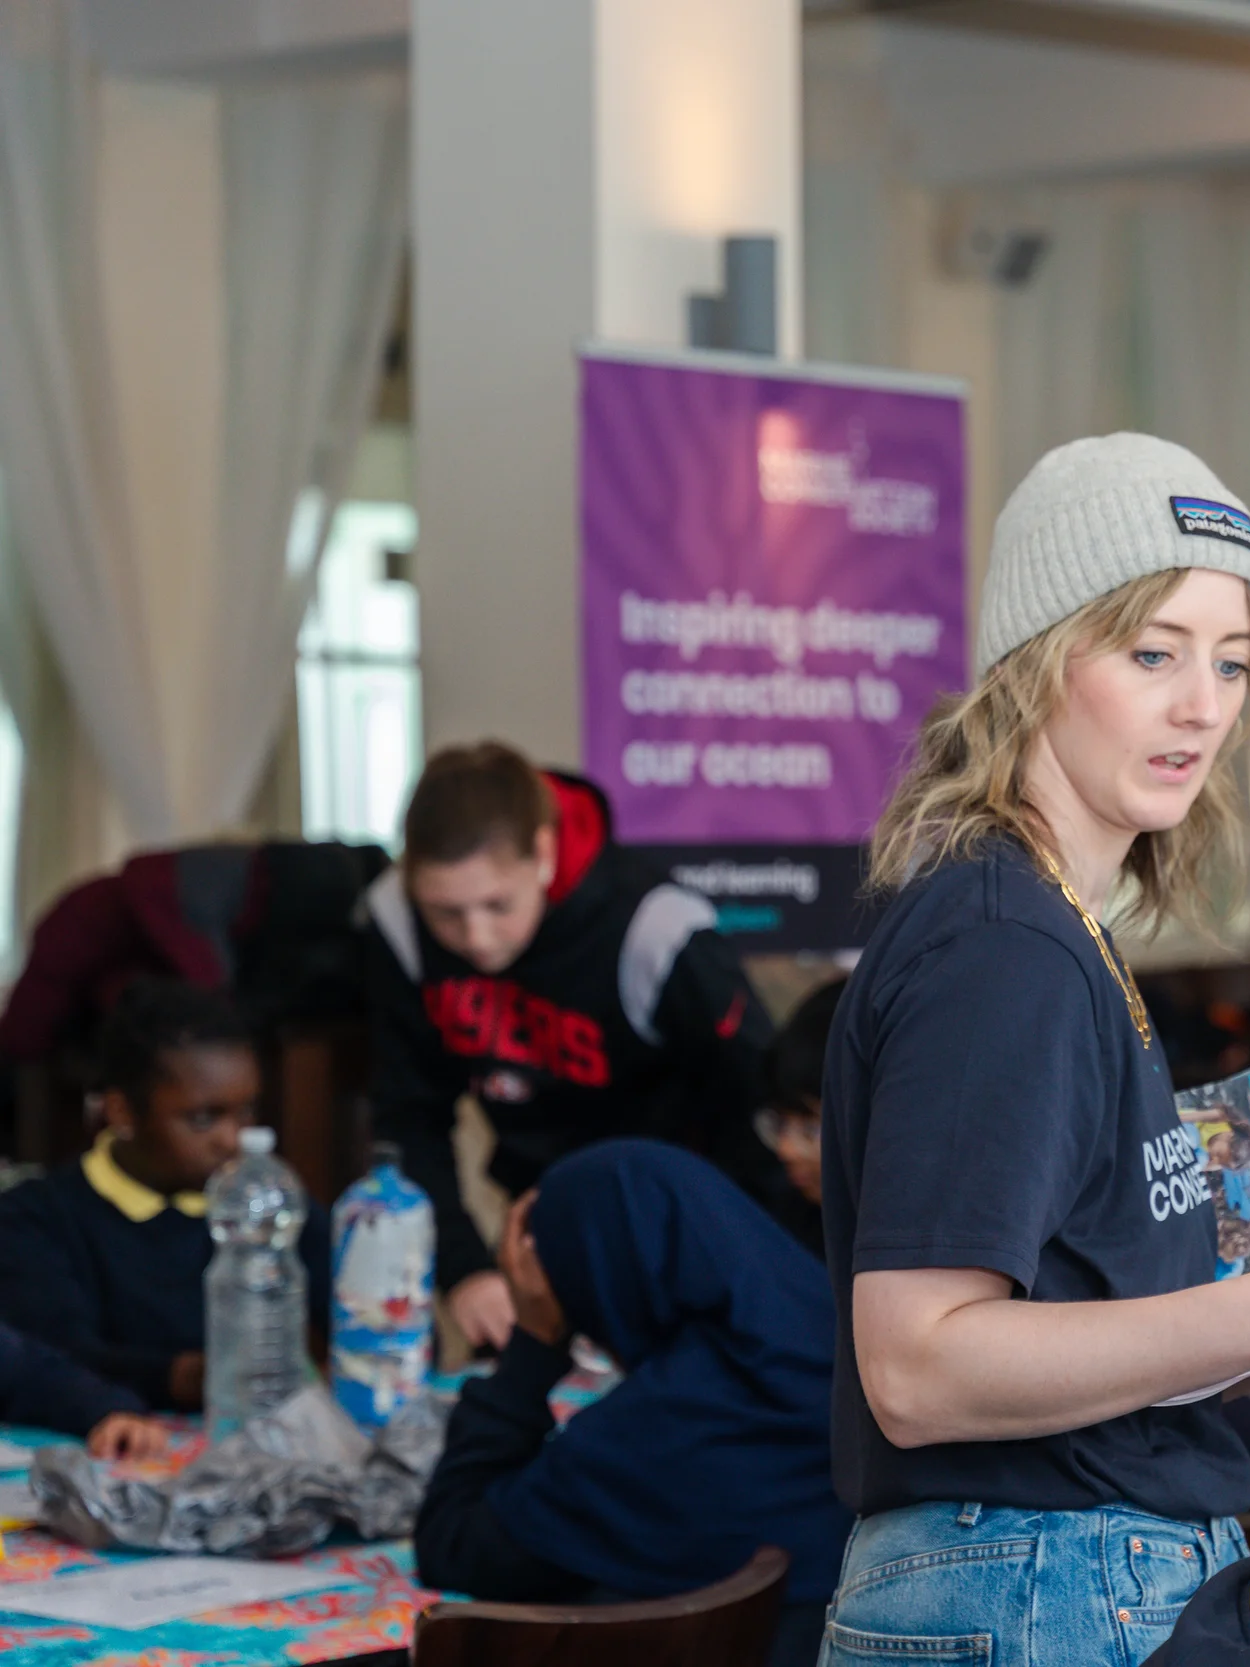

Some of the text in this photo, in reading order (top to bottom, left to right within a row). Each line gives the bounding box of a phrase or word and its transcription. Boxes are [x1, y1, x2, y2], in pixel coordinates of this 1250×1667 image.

[620, 588, 942, 669] Inspiring deeper
[621, 667, 902, 724] connection to
[621, 739, 833, 789] our ocean
